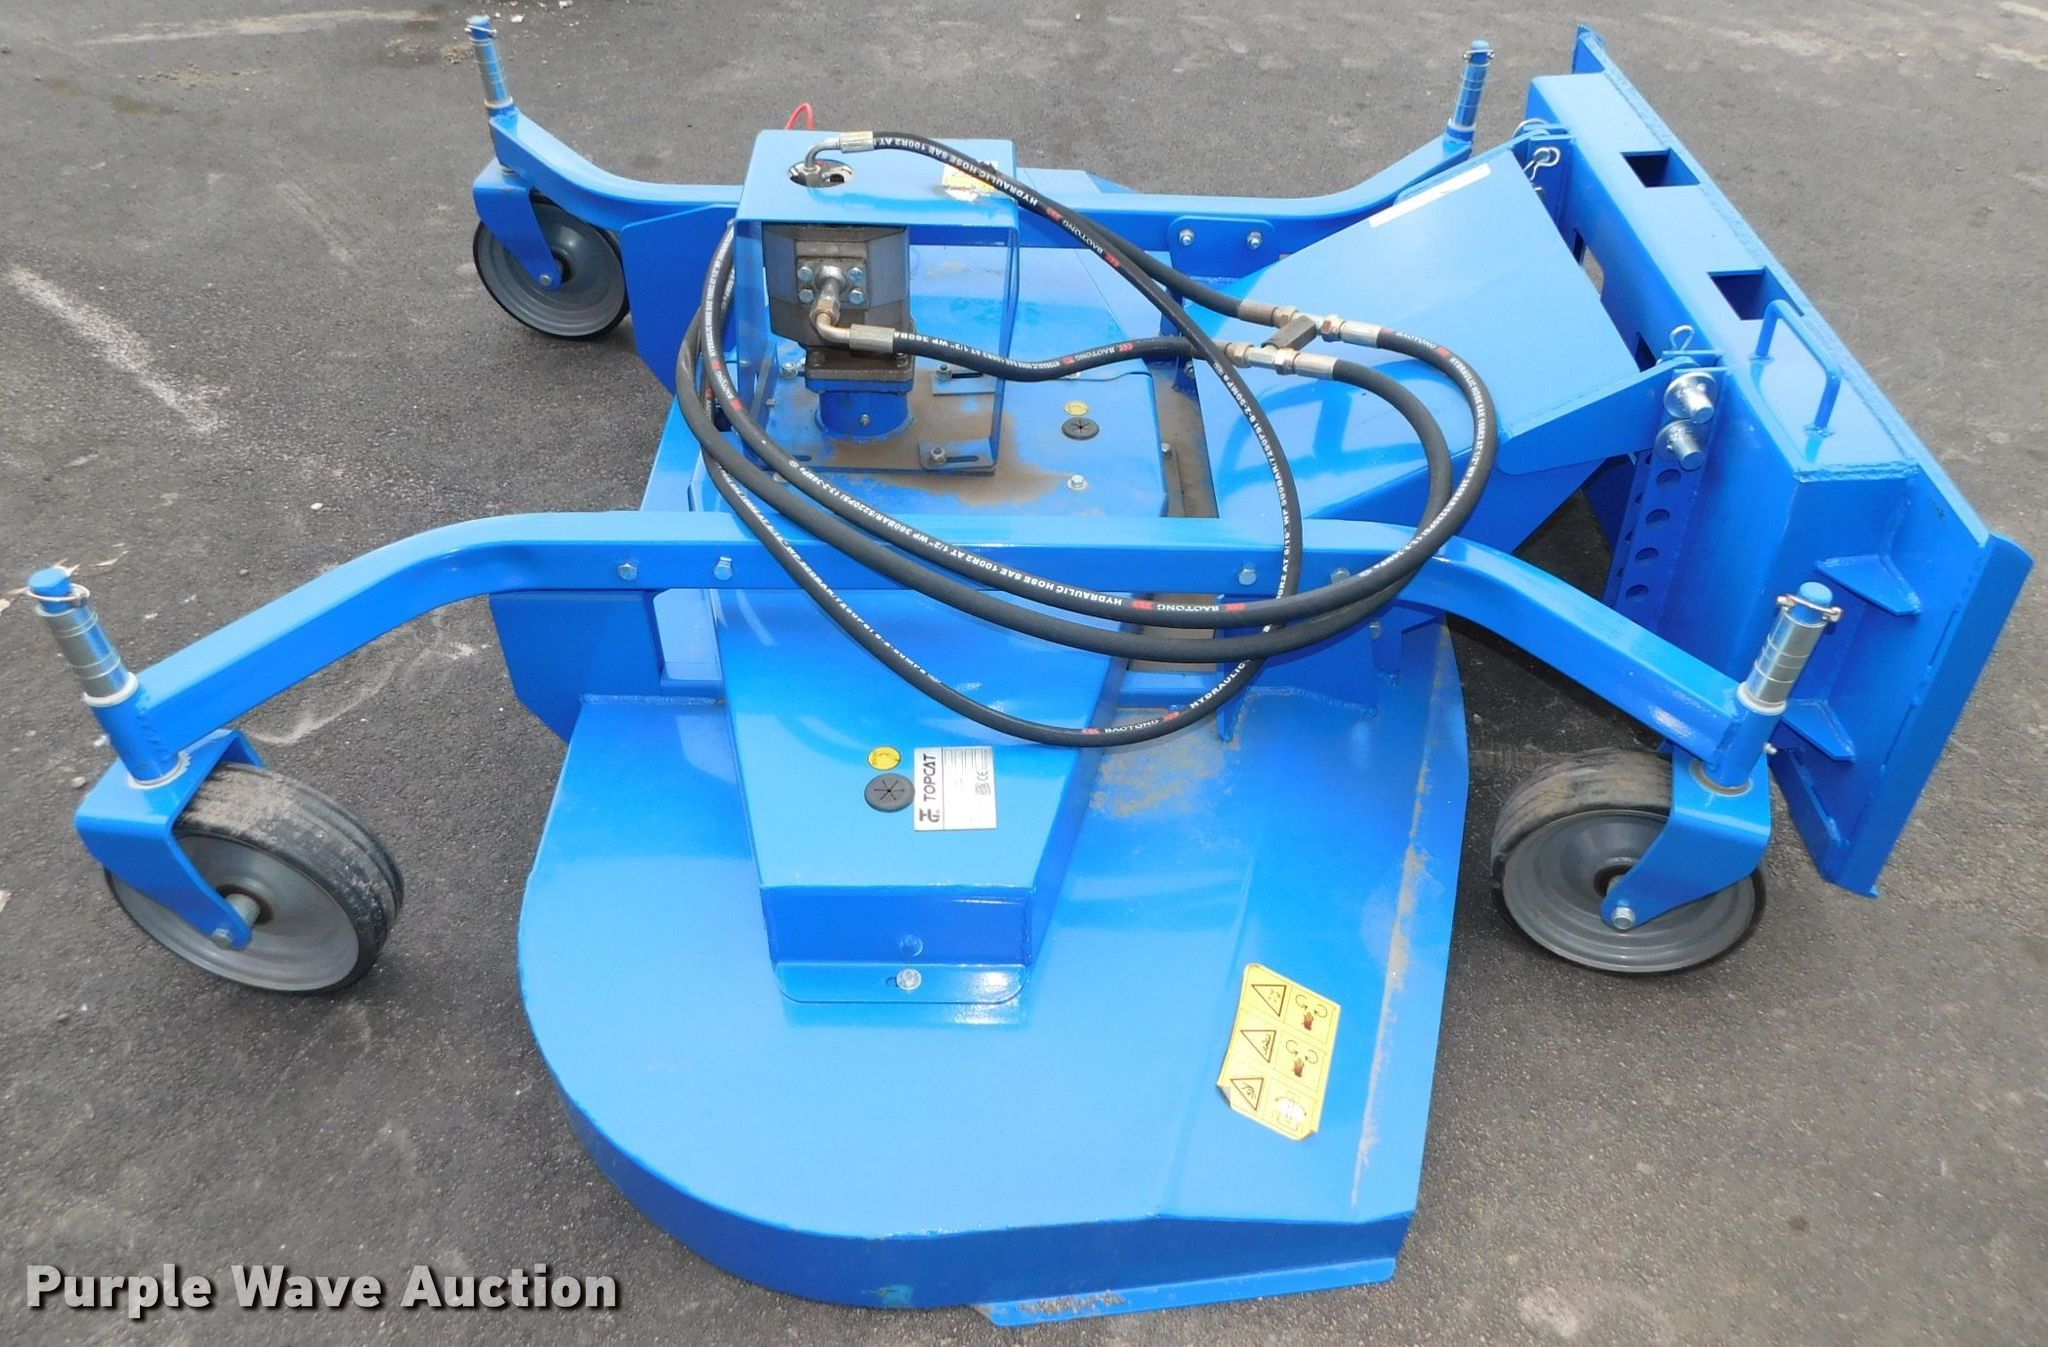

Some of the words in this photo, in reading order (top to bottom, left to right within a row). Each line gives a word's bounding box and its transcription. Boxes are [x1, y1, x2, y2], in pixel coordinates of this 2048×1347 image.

[878, 135, 893, 145] AT
[894, 136, 927, 151] 100R2
[927, 145, 950, 160] SAE
[948, 154, 978, 173] HOSE
[977, 168, 1039, 207] HYDRAULIC
[1061, 218, 1104, 255] BAOTONG
[931, 336, 949, 347] WP
[1074, 345, 1115, 362] BAOTONG
[1448, 354, 1477, 388] HYDRAULIC
[838, 491, 912, 537] 360BAR/5220PSI
[1281, 508, 1289, 525] WP
[910, 529, 929, 544] WP
[927, 537, 950, 554] 1/2"
[949, 547, 965, 559] AT
[965, 553, 999, 572] 100R2
[1281, 558, 1288, 572] AT
[998, 566, 1022, 580] SAE
[1022, 574, 1055, 591] HOSE
[1055, 584, 1123, 605] HYDRAULIC
[1155, 603, 1219, 612] BAOTONG
[1103, 718, 1159, 733] BAOTONG
[1188, 661, 1246, 709] HYDRAULIC
[923, 753, 936, 802] TOPCAT
